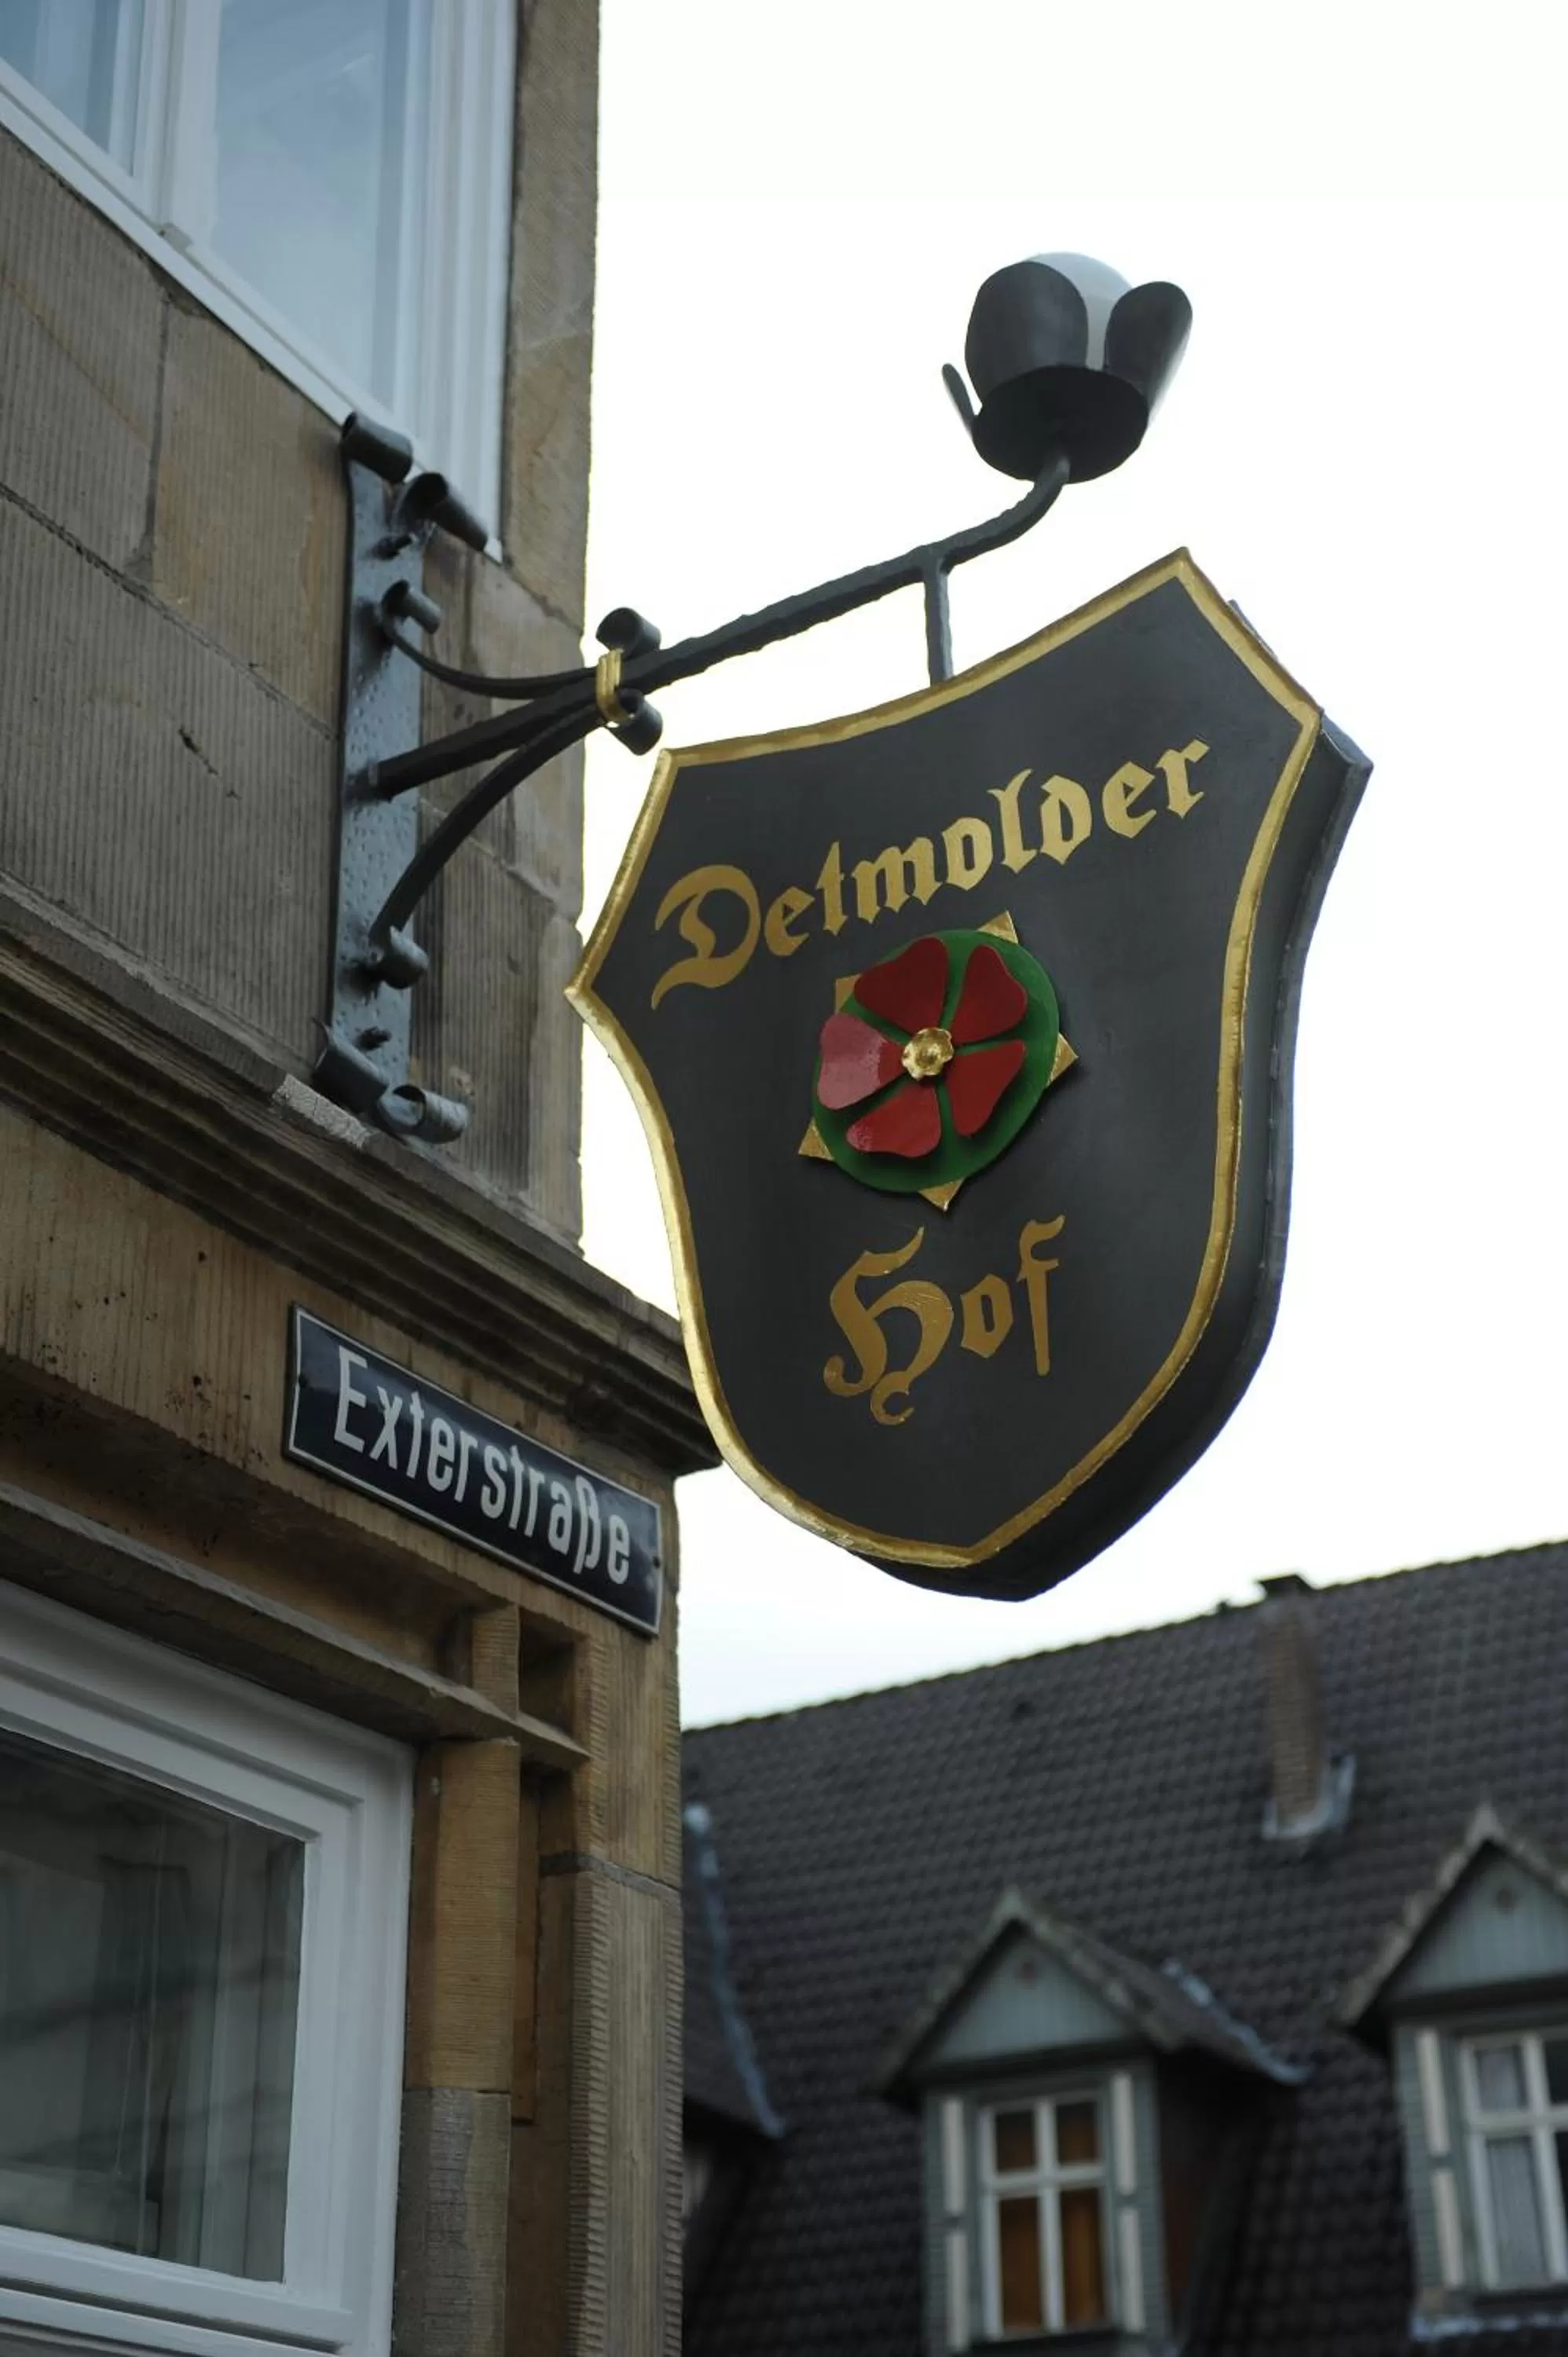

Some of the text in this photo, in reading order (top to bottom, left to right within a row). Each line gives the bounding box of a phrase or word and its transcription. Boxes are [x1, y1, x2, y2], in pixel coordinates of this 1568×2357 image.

[651, 738, 1211, 1011] Detmolder
[823, 1215, 1065, 1426] Hof
[334, 1344, 632, 1585] Exterstraße
